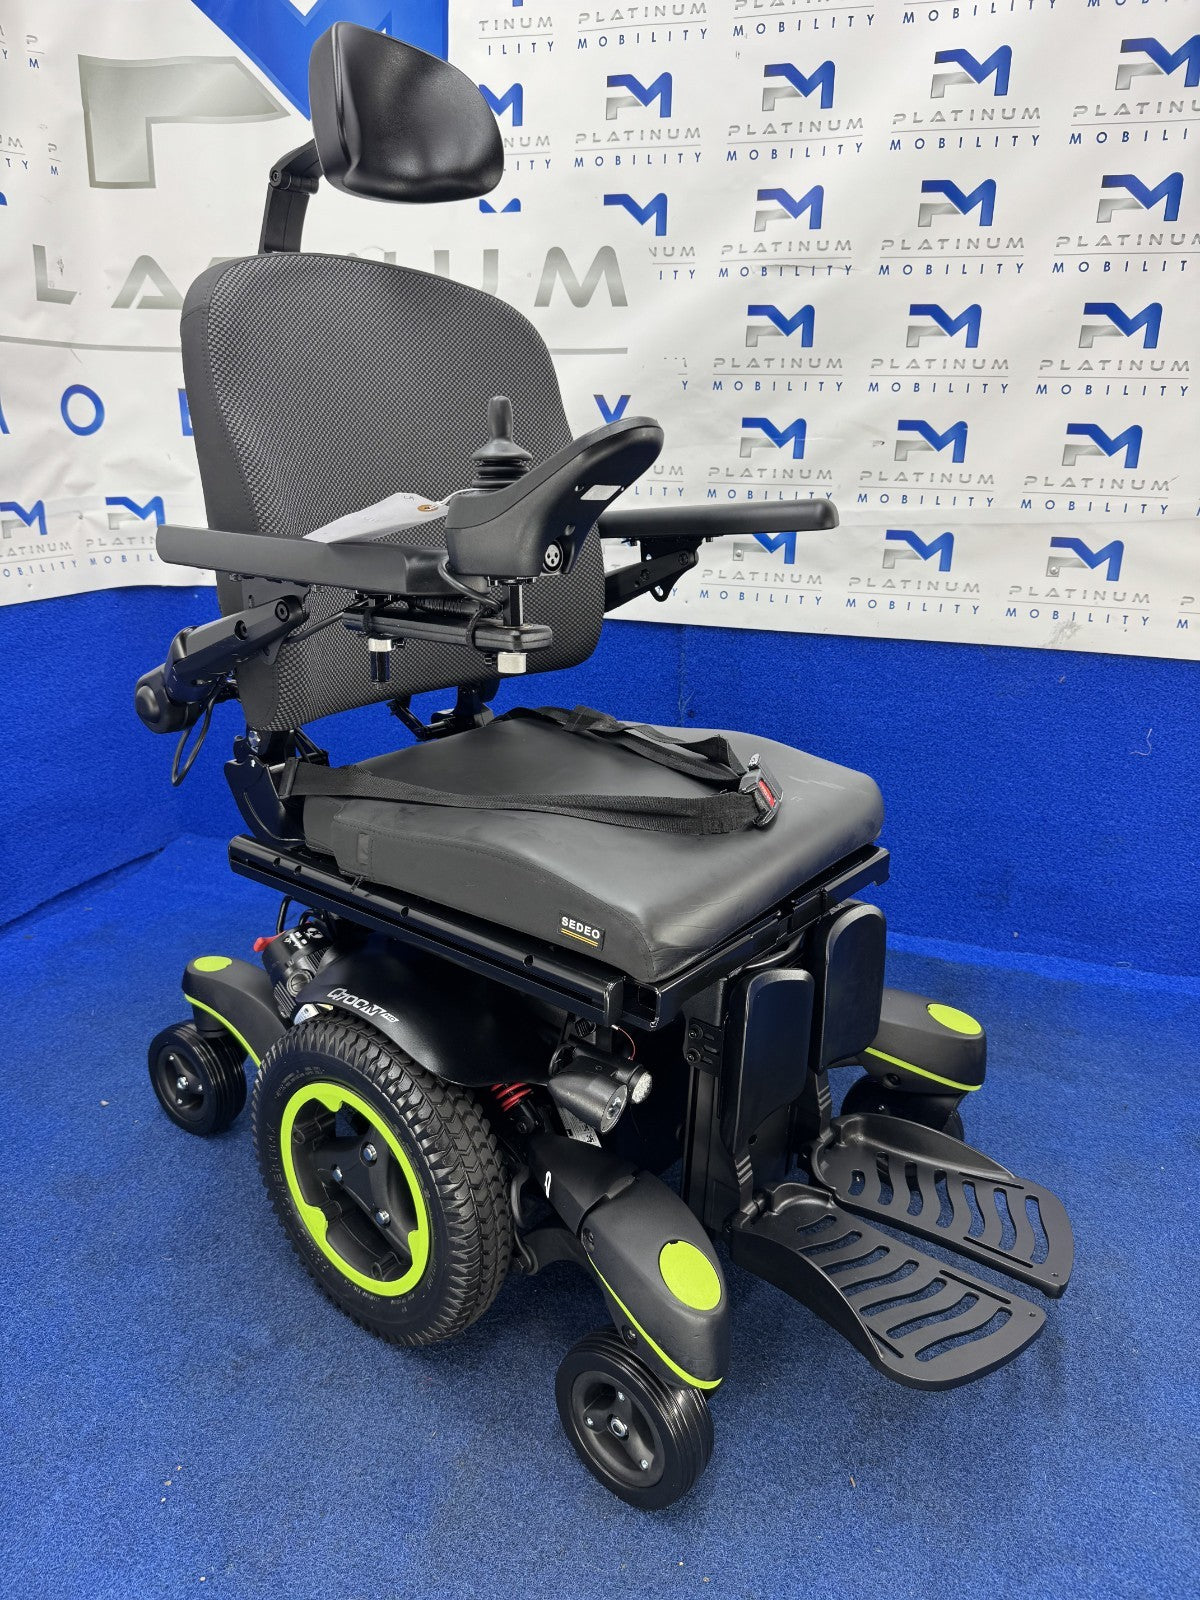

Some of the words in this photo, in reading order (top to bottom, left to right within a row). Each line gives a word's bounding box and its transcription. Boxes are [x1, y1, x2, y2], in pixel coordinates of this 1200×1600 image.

[578, 2, 707, 24] PLATINUM
[478, 16, 553, 31] TINUM
[733, 14, 875, 37] MOBILITY
[577, 28, 707, 49] MOBILITY
[488, 41, 554, 56] ILITY
[892, 107, 1041, 125] PLATINUM
[728, 117, 864, 137] PLATINUM
[575, 127, 701, 144] PLATINUM
[890, 134, 1040, 151] MOBILITY
[574, 152, 701, 168] MOBILITY
[726, 142, 863, 162] MOBILITY
[721, 239, 853, 255] PLATINUM
[881, 237, 1025, 251] PLATINUM
[718, 265, 853, 278] MOBILITY
[878, 263, 1024, 276] MOBILITY
[713, 357, 843, 369] PLATINUM
[870, 358, 1009, 370] PLATINUM
[1039, 359, 1190, 372] PLATINUM
[712, 380, 843, 392] MOBILITY
[868, 382, 1009, 394] MOBILITY
[1035, 383, 1189, 397] MOBILITY
[708, 467, 832, 480] PLATINUM
[860, 470, 995, 484] PLATINUM
[1023, 475, 1170, 491] PLATINUM
[857, 493, 994, 507] MOBILITY
[1020, 500, 1168, 515] MOBILITY
[0, 541, 73, 557] ATINUM
[702, 569, 822, 585] PLATINUM
[848, 577, 980, 593] PLATINUM
[700, 590, 822, 605] MOBILITY
[1008, 586, 1150, 604] PLATINUM
[846, 598, 980, 615] MOBILITY
[1005, 607, 1149, 626] MOBILITY
[561, 916, 600, 939] SEDEO
